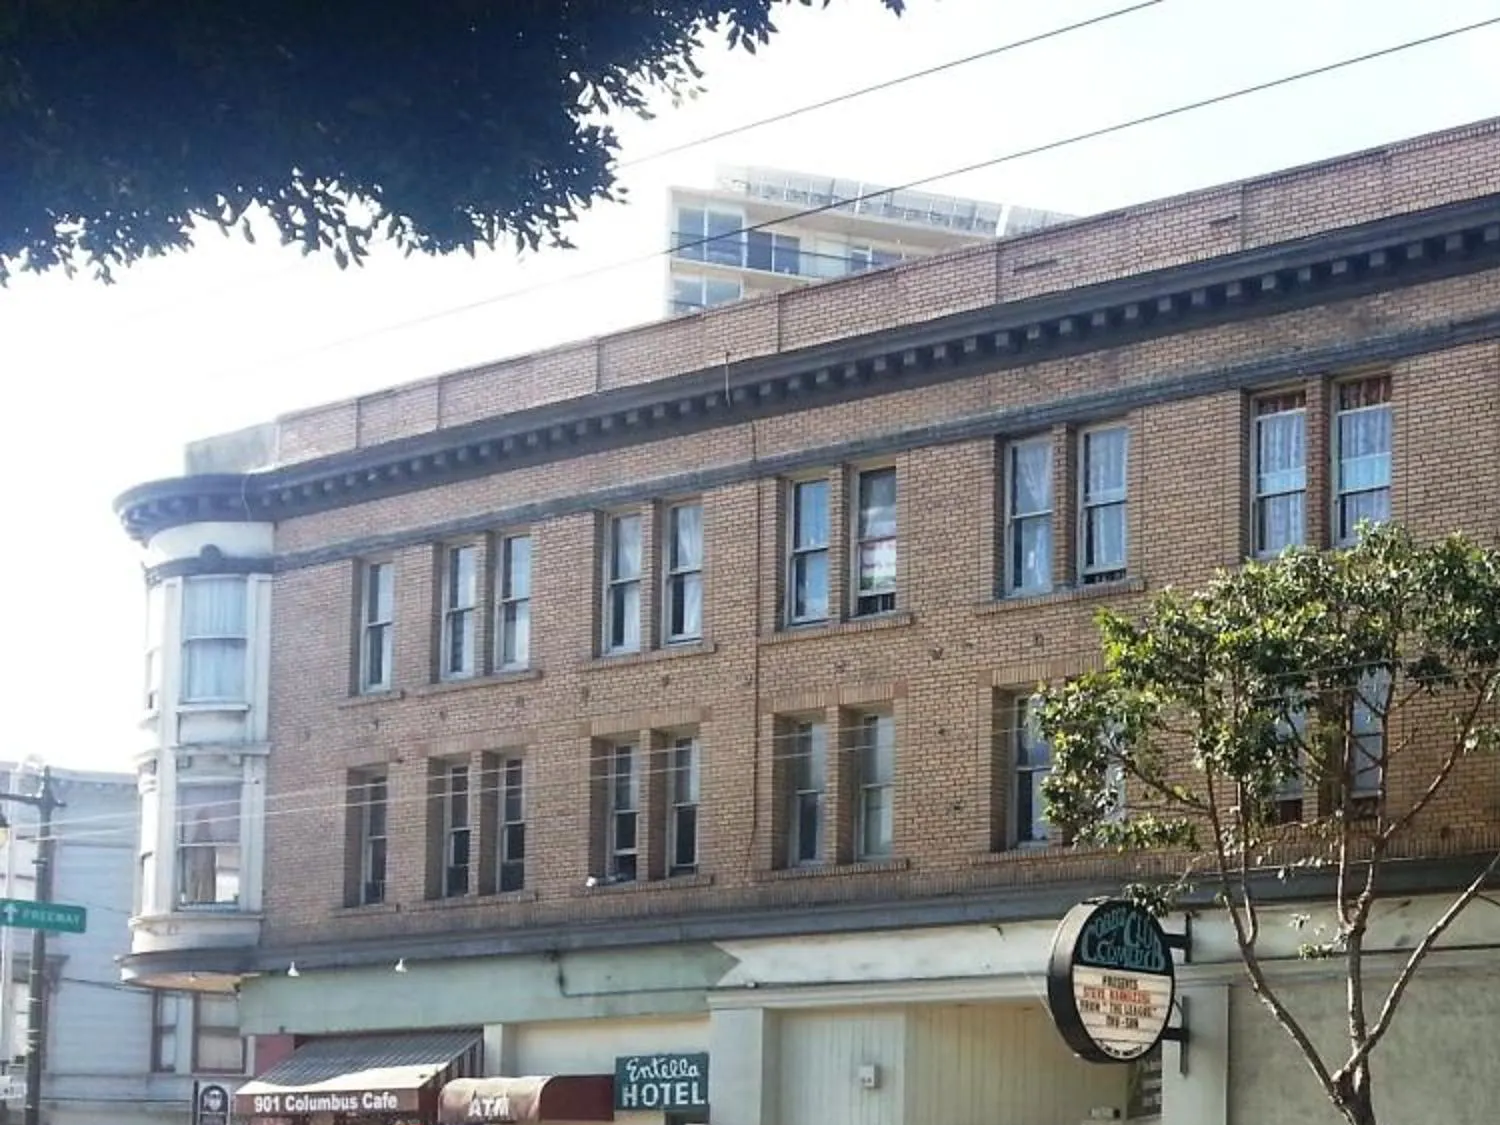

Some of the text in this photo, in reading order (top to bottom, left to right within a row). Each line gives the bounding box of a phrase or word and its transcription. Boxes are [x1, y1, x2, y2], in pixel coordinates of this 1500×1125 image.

[626, 1057, 700, 1082] Entella
[254, 1091, 398, 1112] 901 Columbus Cafe
[622, 1081, 706, 1107] HOTEL
[468, 1096, 510, 1117] ATM
